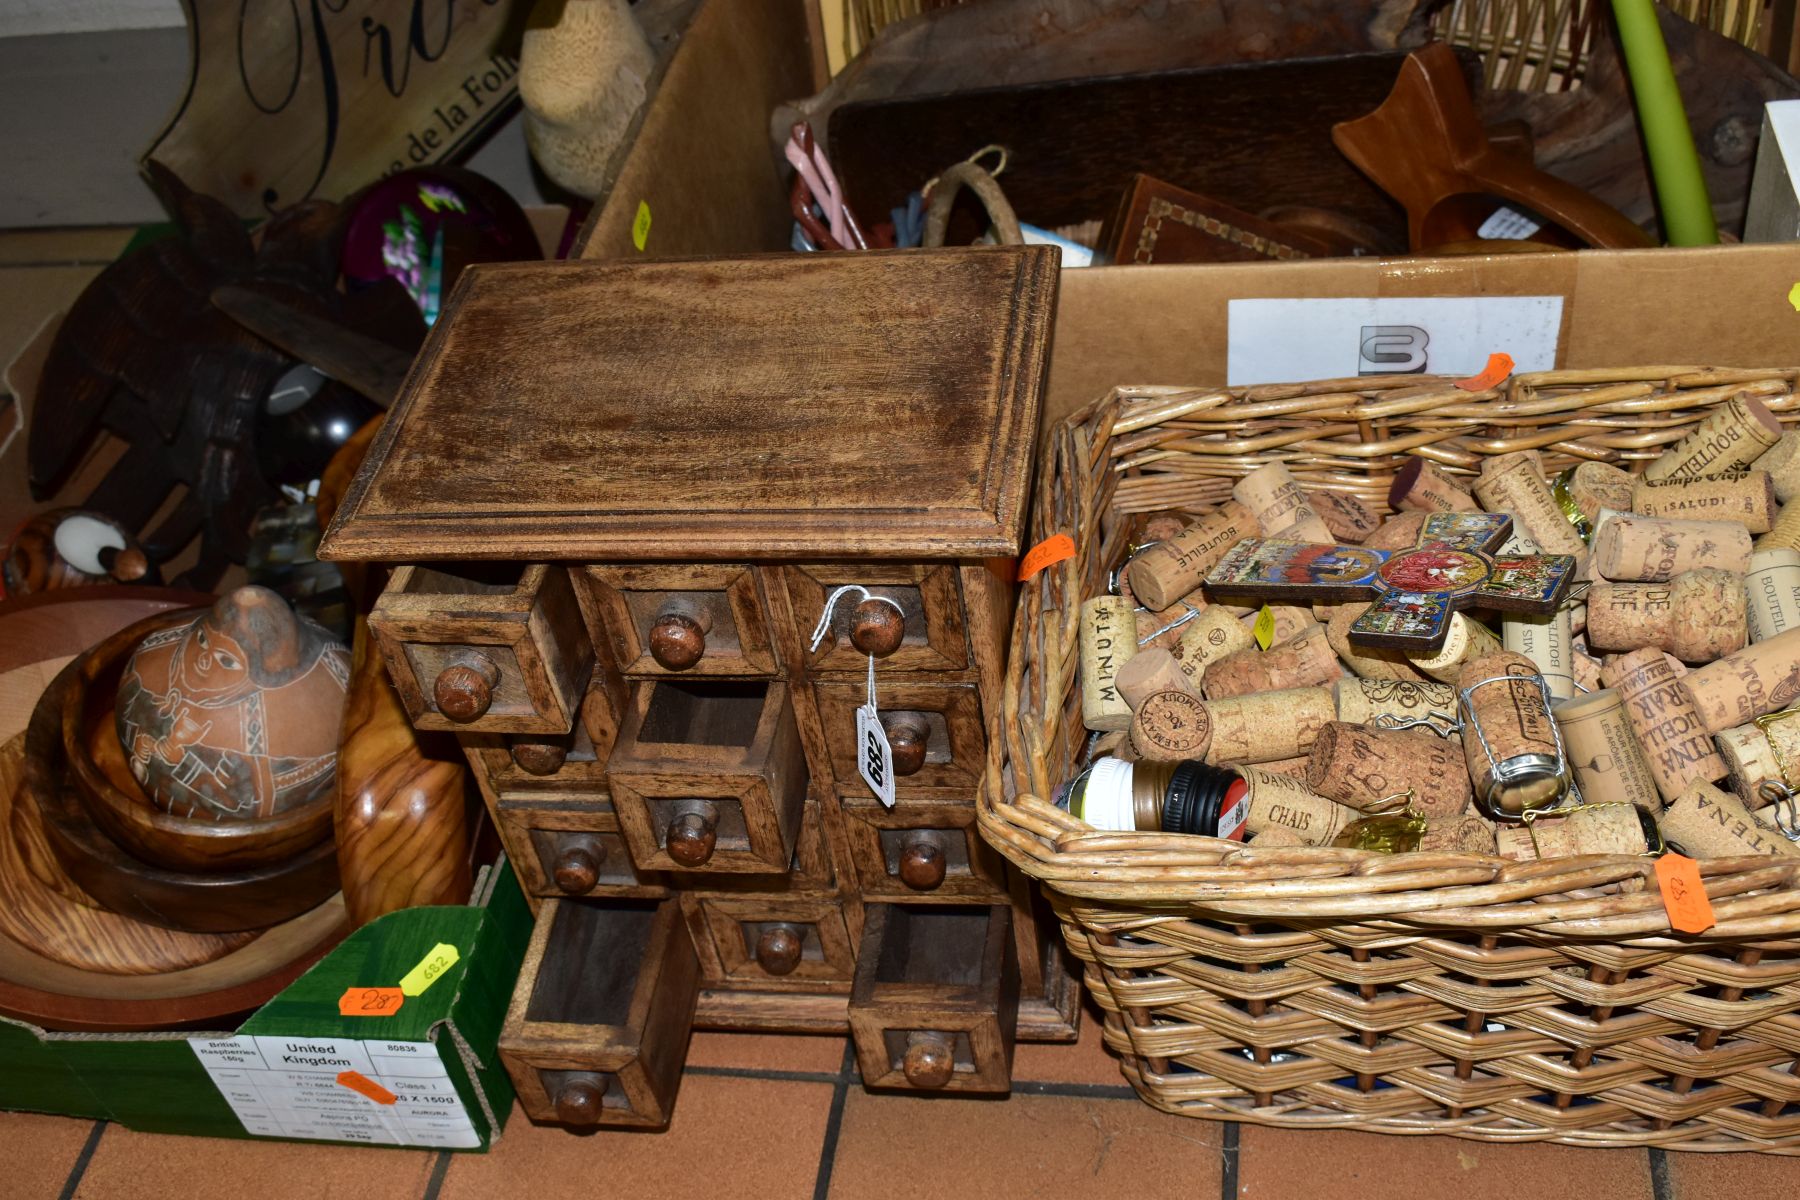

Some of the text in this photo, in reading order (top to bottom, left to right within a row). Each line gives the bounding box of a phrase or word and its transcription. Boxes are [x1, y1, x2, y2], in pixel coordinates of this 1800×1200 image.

[408, 56, 519, 163] de la Foll
[1667, 425, 1741, 479] BOUTEILL
[1645, 472, 1748, 489] Campo Viejo
[1520, 467, 1563, 529] MEIRANA
[1177, 526, 1238, 568] BOUTEILLE
[1645, 590, 1671, 611] DE
[1761, 576, 1787, 632] BOUTEIL
[1522, 629, 1533, 654] MIS
[1548, 619, 1561, 668] BOUTE
[1612, 725, 1627, 749] POUR
[867, 730, 883, 787] 682
[1599, 719, 1611, 735] LES
[1619, 771, 1629, 783] DE
[1624, 784, 1633, 796] CE
[1259, 771, 1296, 792] DANS
[1268, 804, 1312, 831] CHAIS
[424, 956, 448, 980] 682
[200, 1048, 256, 1056] Raspberries
[285, 1043, 336, 1054] United
[387, 1044, 417, 1053] 80836
[283, 1055, 351, 1067] Kingdom
[394, 1081, 426, 1090] Class
[424, 1096, 454, 1105] 150g
